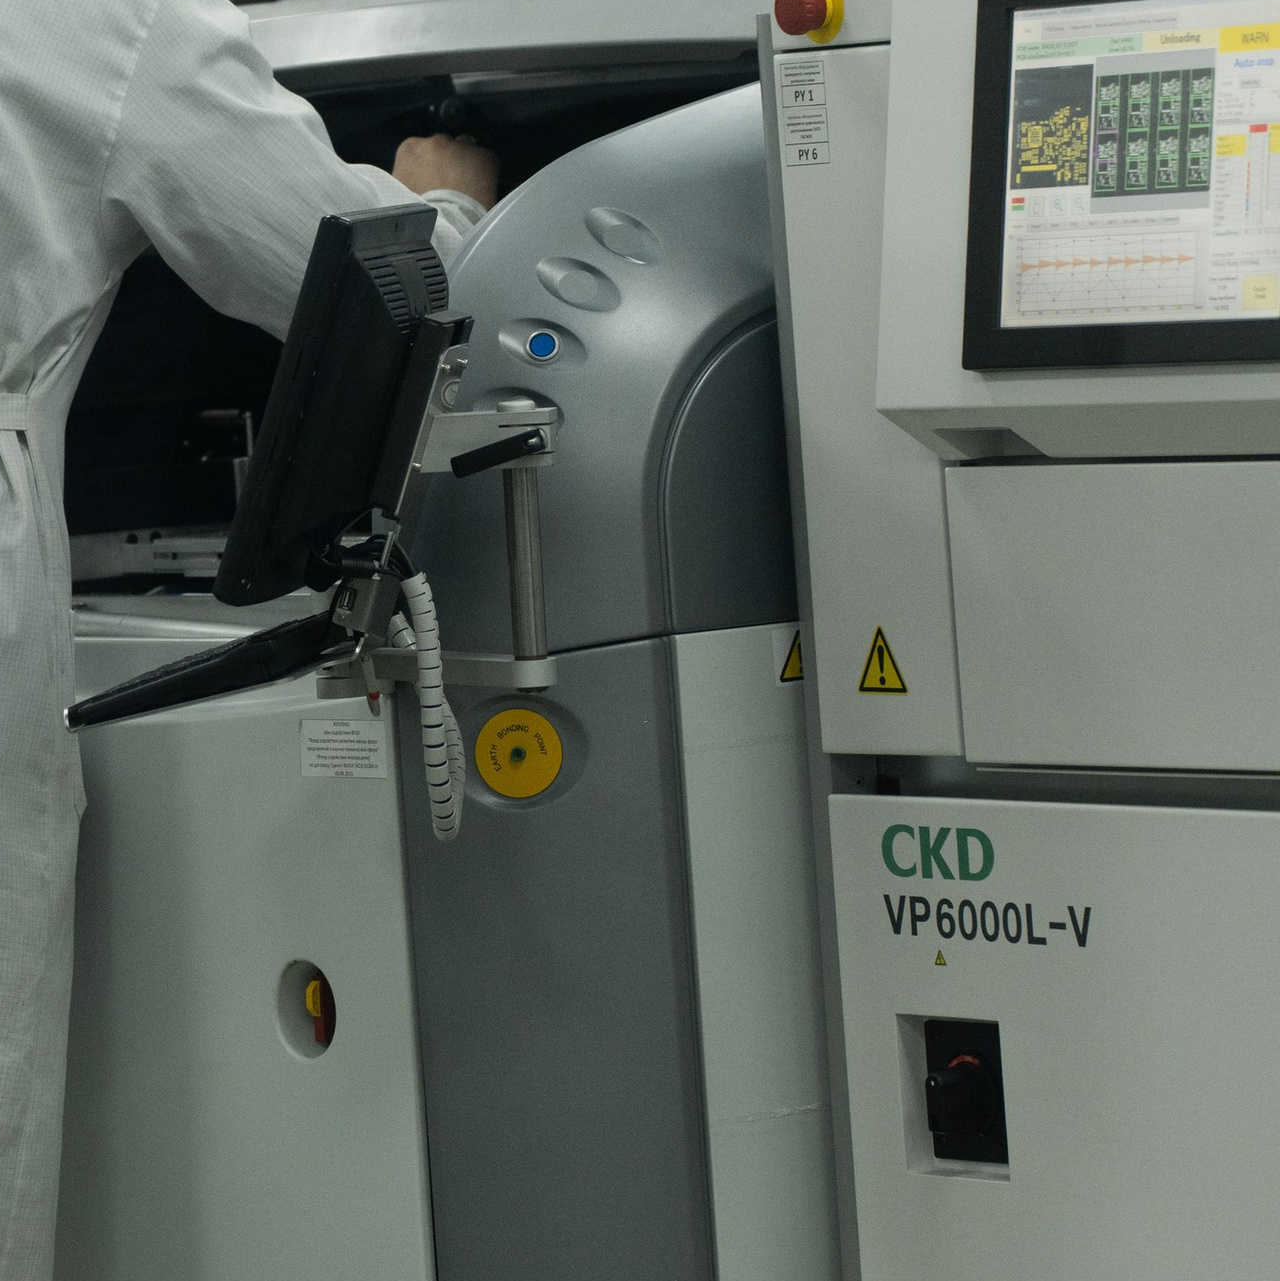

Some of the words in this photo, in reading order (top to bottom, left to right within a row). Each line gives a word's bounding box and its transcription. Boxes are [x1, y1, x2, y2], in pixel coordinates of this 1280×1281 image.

[1160, 32, 1202, 45] Unloading
[1241, 31, 1270, 45] WARN
[1234, 56, 1254, 69] Auto
[808, 89, 814, 101] 1
[812, 147, 818, 160] 6
[496, 724, 530, 739] BONDING
[533, 732, 547, 756] POINT
[489, 744, 502, 772] EARTH
[881, 823, 996, 882] CKD
[882, 893, 1092, 949] VP6000L-V
